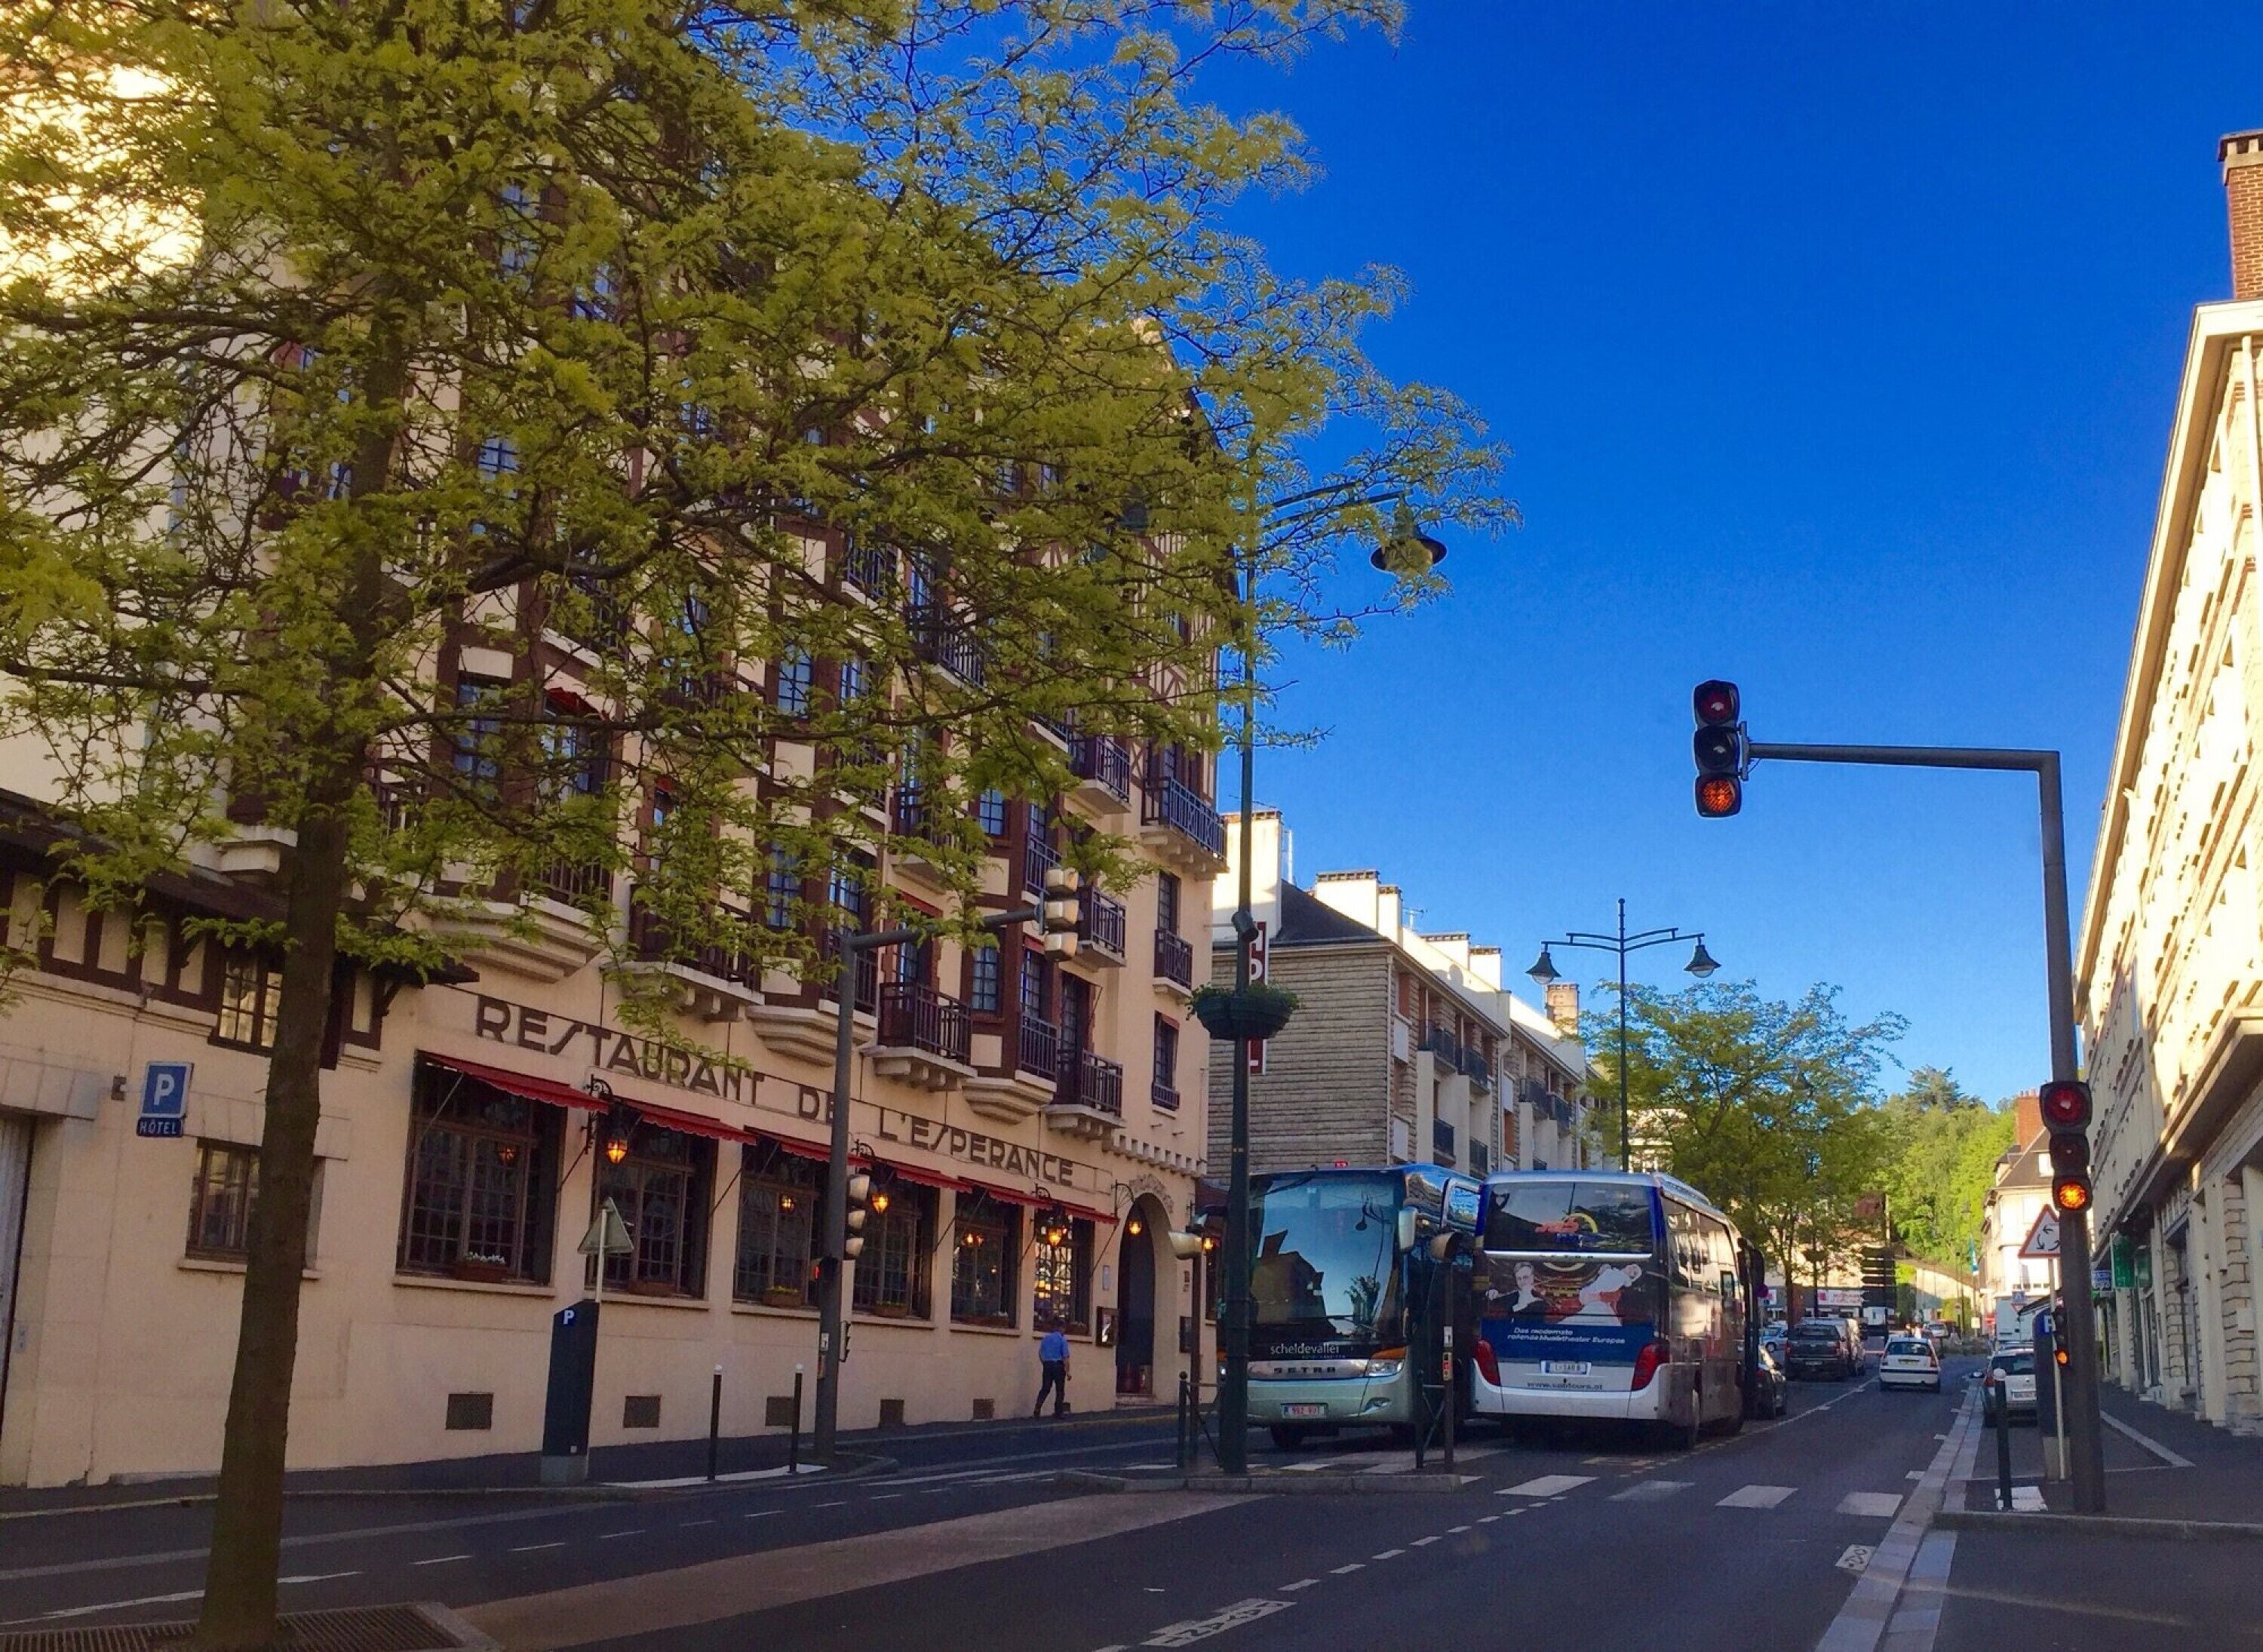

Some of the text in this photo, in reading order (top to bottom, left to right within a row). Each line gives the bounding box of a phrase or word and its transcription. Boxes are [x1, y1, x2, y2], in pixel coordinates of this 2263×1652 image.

[476, 996, 764, 1106] RESTAURANT
[154, 1073, 175, 1105] P
[140, 1119, 177, 1135] HÔTEL
[563, 1310, 574, 1325] P
